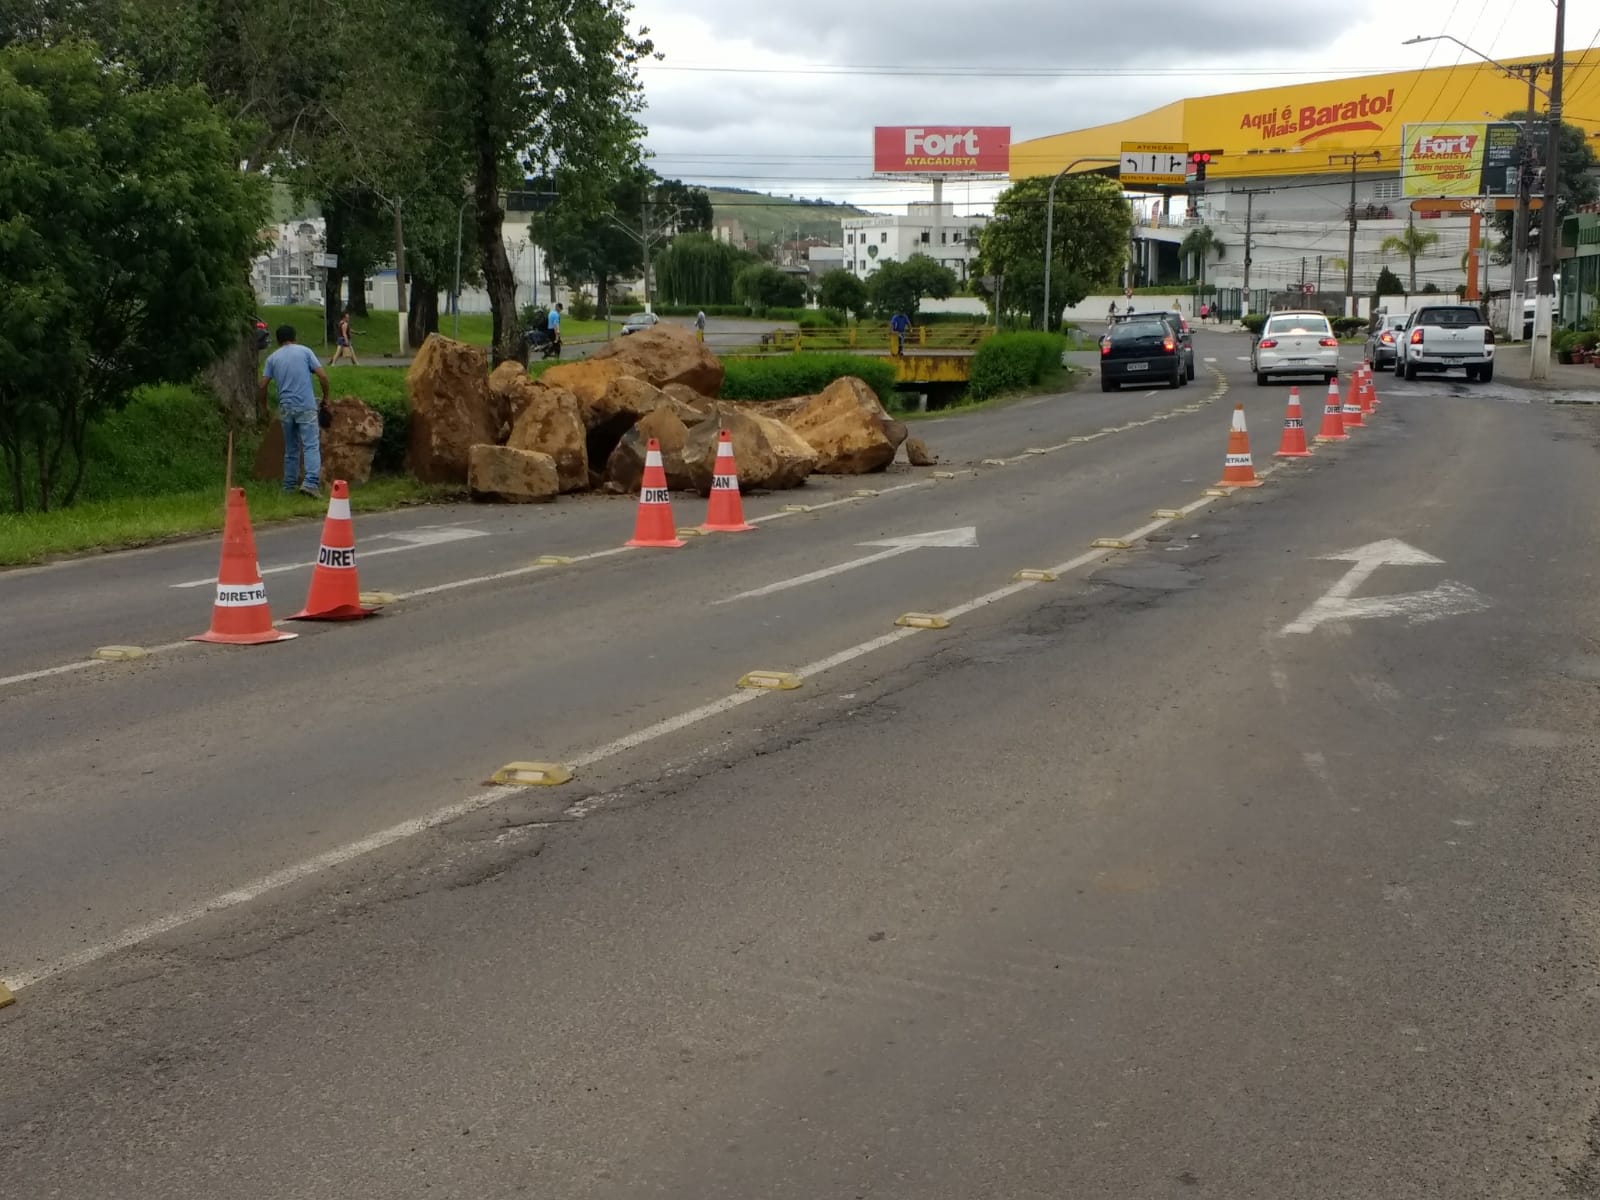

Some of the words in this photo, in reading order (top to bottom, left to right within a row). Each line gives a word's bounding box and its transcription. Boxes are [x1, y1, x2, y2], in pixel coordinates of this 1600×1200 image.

[1240, 108, 1277, 130] Aqui
[1281, 105, 1292, 121] é
[1262, 120, 1298, 140] Mais
[1298, 88, 1395, 132] Barato!
[905, 128, 980, 156] Fort
[1419, 135, 1471, 154] Fort
[904, 157, 978, 167] ATACADISTA
[1409, 152, 1473, 160] ATACADISTA
[645, 489, 670, 502] DIRE
